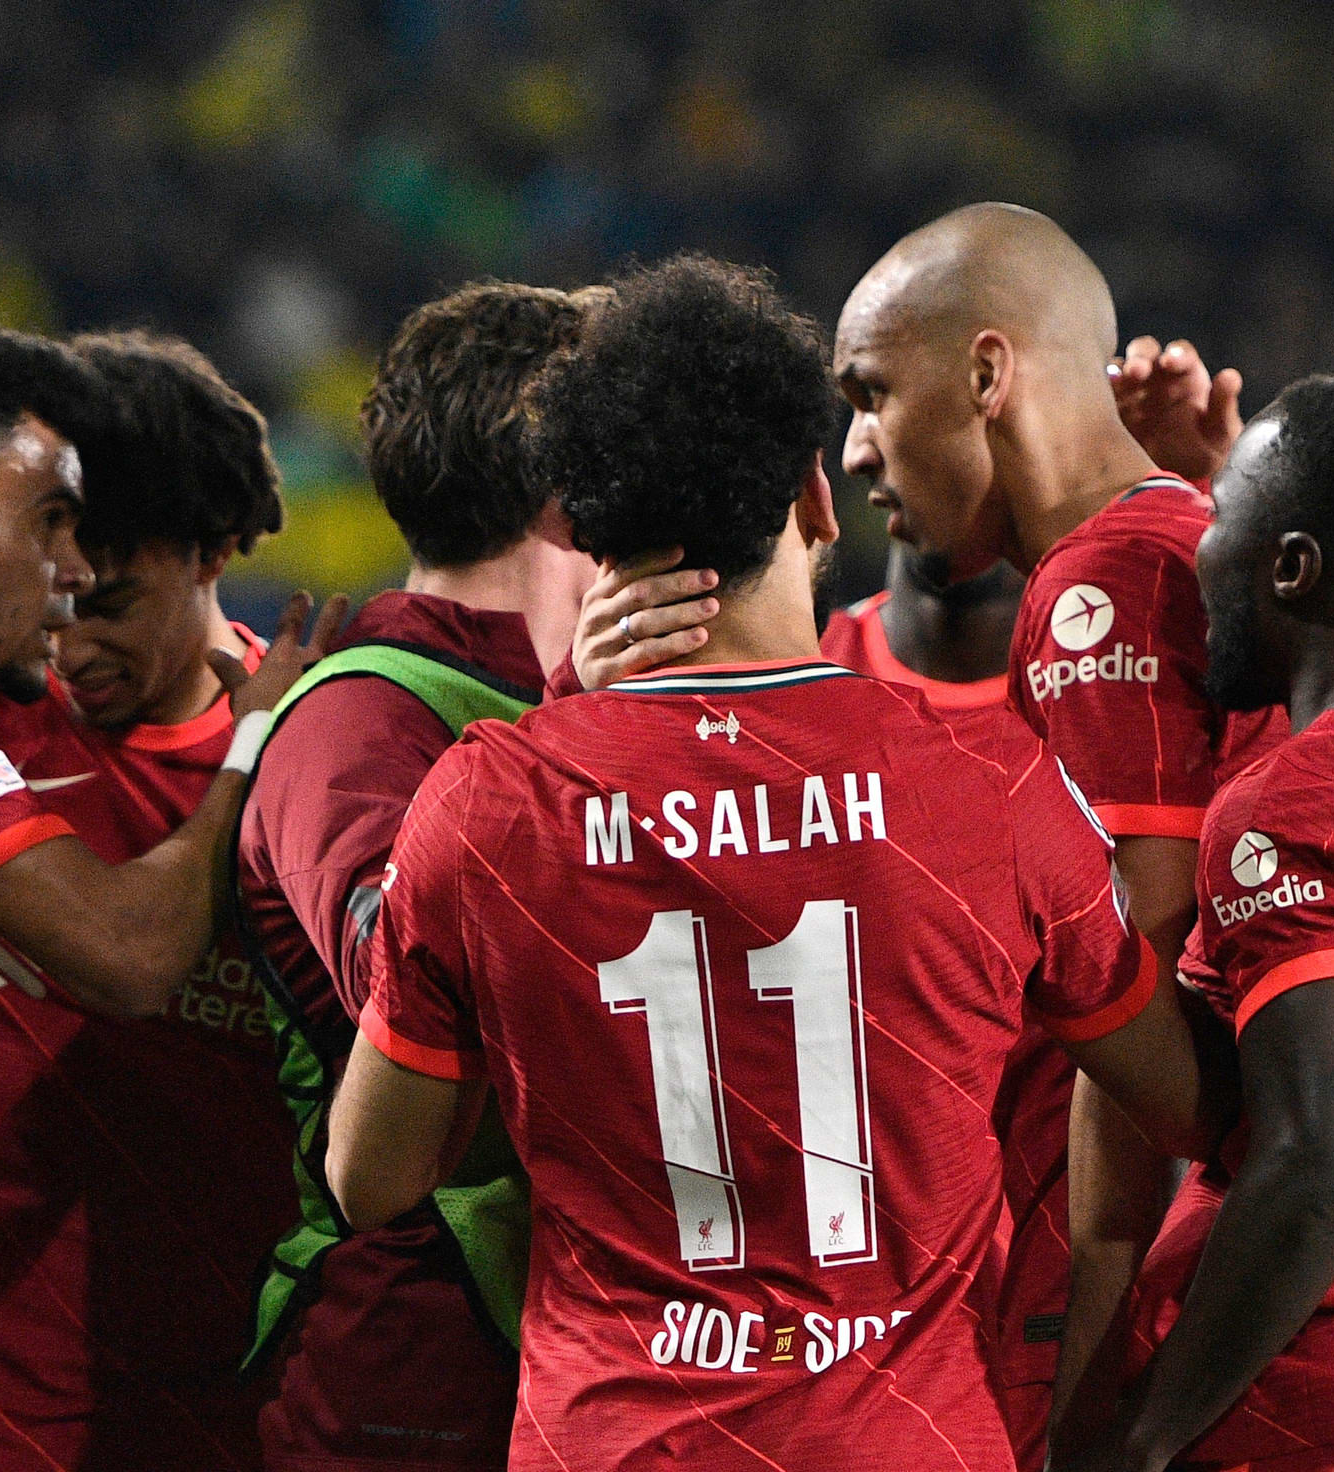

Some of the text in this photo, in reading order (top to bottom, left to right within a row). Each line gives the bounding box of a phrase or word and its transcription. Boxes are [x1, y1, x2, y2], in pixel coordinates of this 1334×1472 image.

[1027, 642, 1159, 702] Expedia
[709, 720, 726, 734] 96
[1212, 875, 1325, 928] Expedia
[597, 899, 878, 1272] 11
[651, 1301, 764, 1373] SIDE
